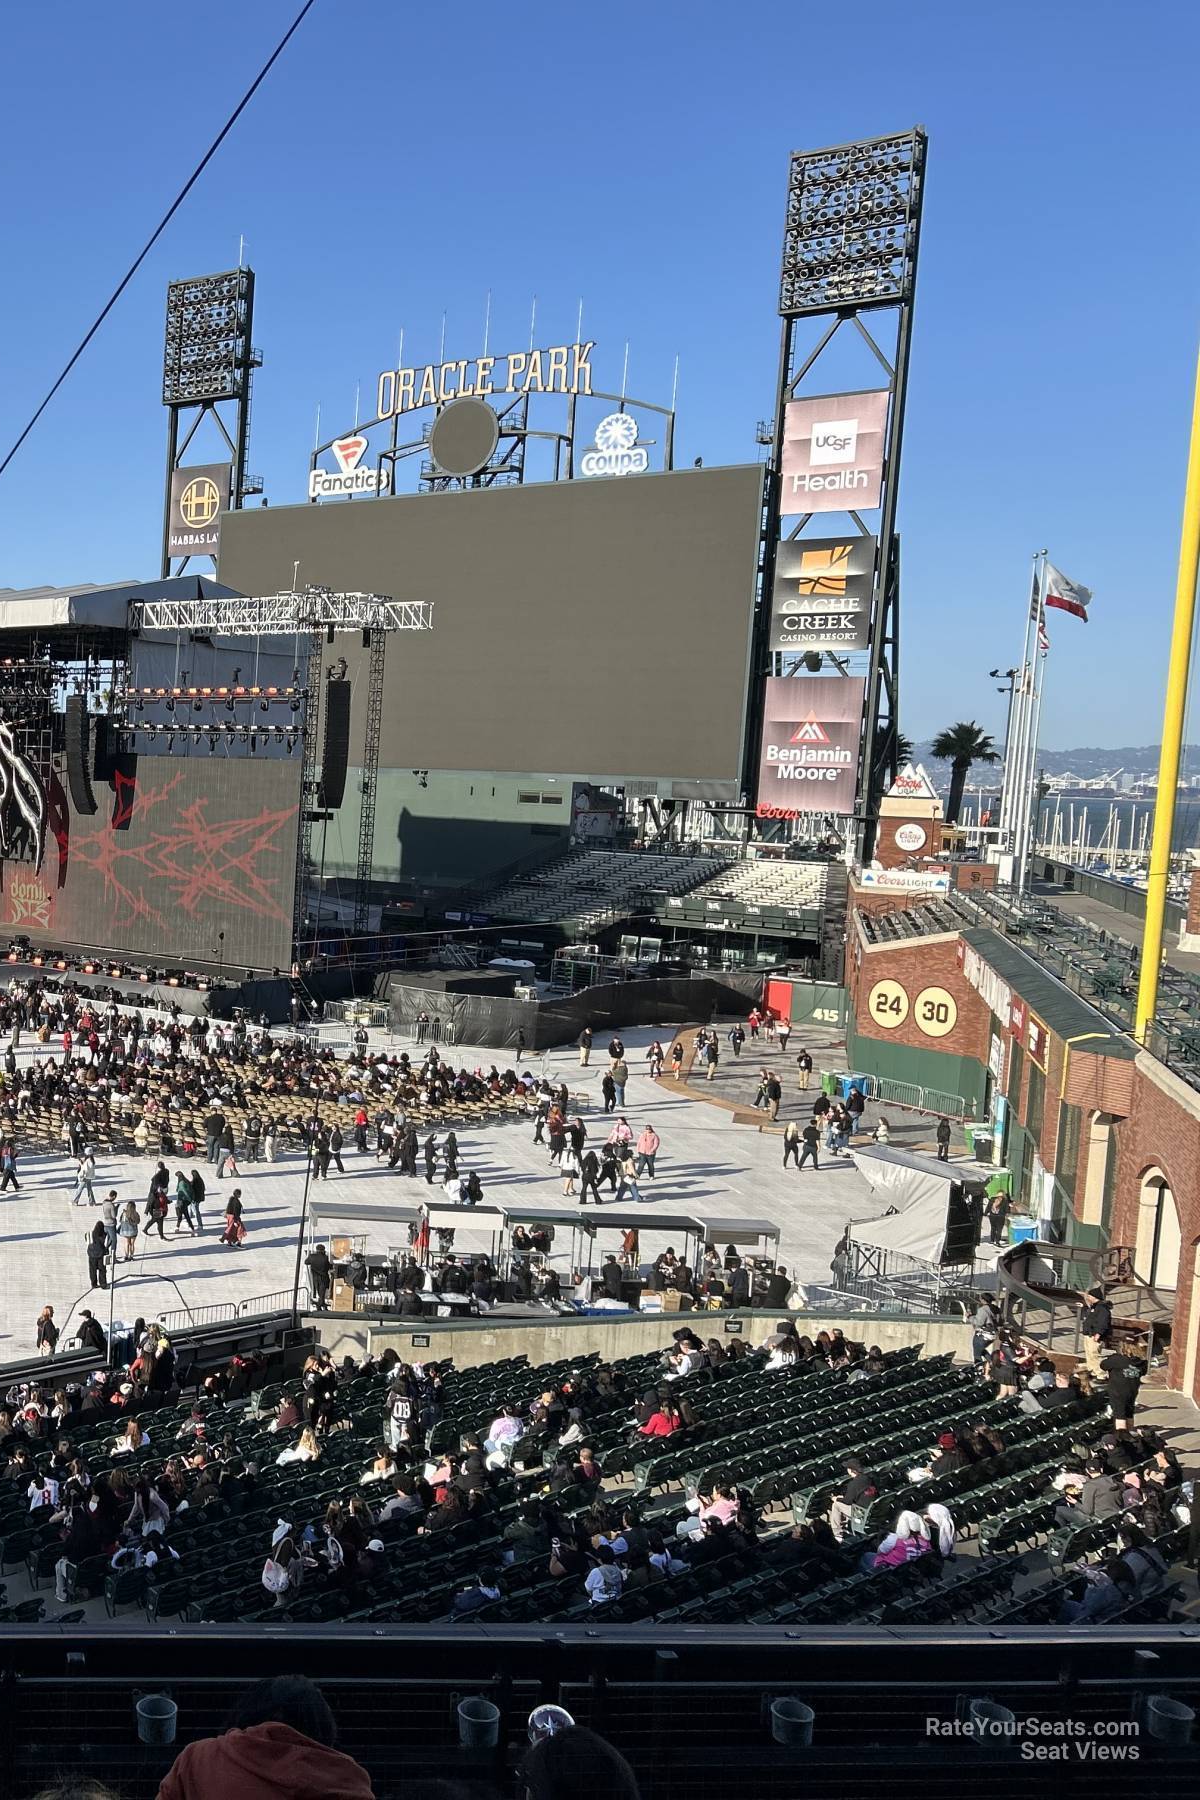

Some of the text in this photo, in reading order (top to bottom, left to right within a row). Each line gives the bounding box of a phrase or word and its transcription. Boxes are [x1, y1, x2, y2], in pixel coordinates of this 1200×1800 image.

[377, 342, 595, 420] ORACLE PARK
[815, 434, 852, 451] UCSF
[585, 452, 644, 474] coupa
[792, 470, 868, 493] Health
[171, 533, 205, 546] HABBAS
[782, 597, 861, 613] CACHE
[782, 614, 856, 630] CREEK
[780, 632, 858, 642] CASINO RESORT
[766, 745, 852, 765] Benjamin
[777, 764, 838, 781] Moore
[895, 776, 922, 789] Coors
[756, 802, 840, 821] Coors LIGHT
[877, 874, 933, 887] Coors LIGHT
[876, 993, 902, 1015] 24
[922, 1001, 949, 1023] 30
[812, 1007, 839, 1022] 415
